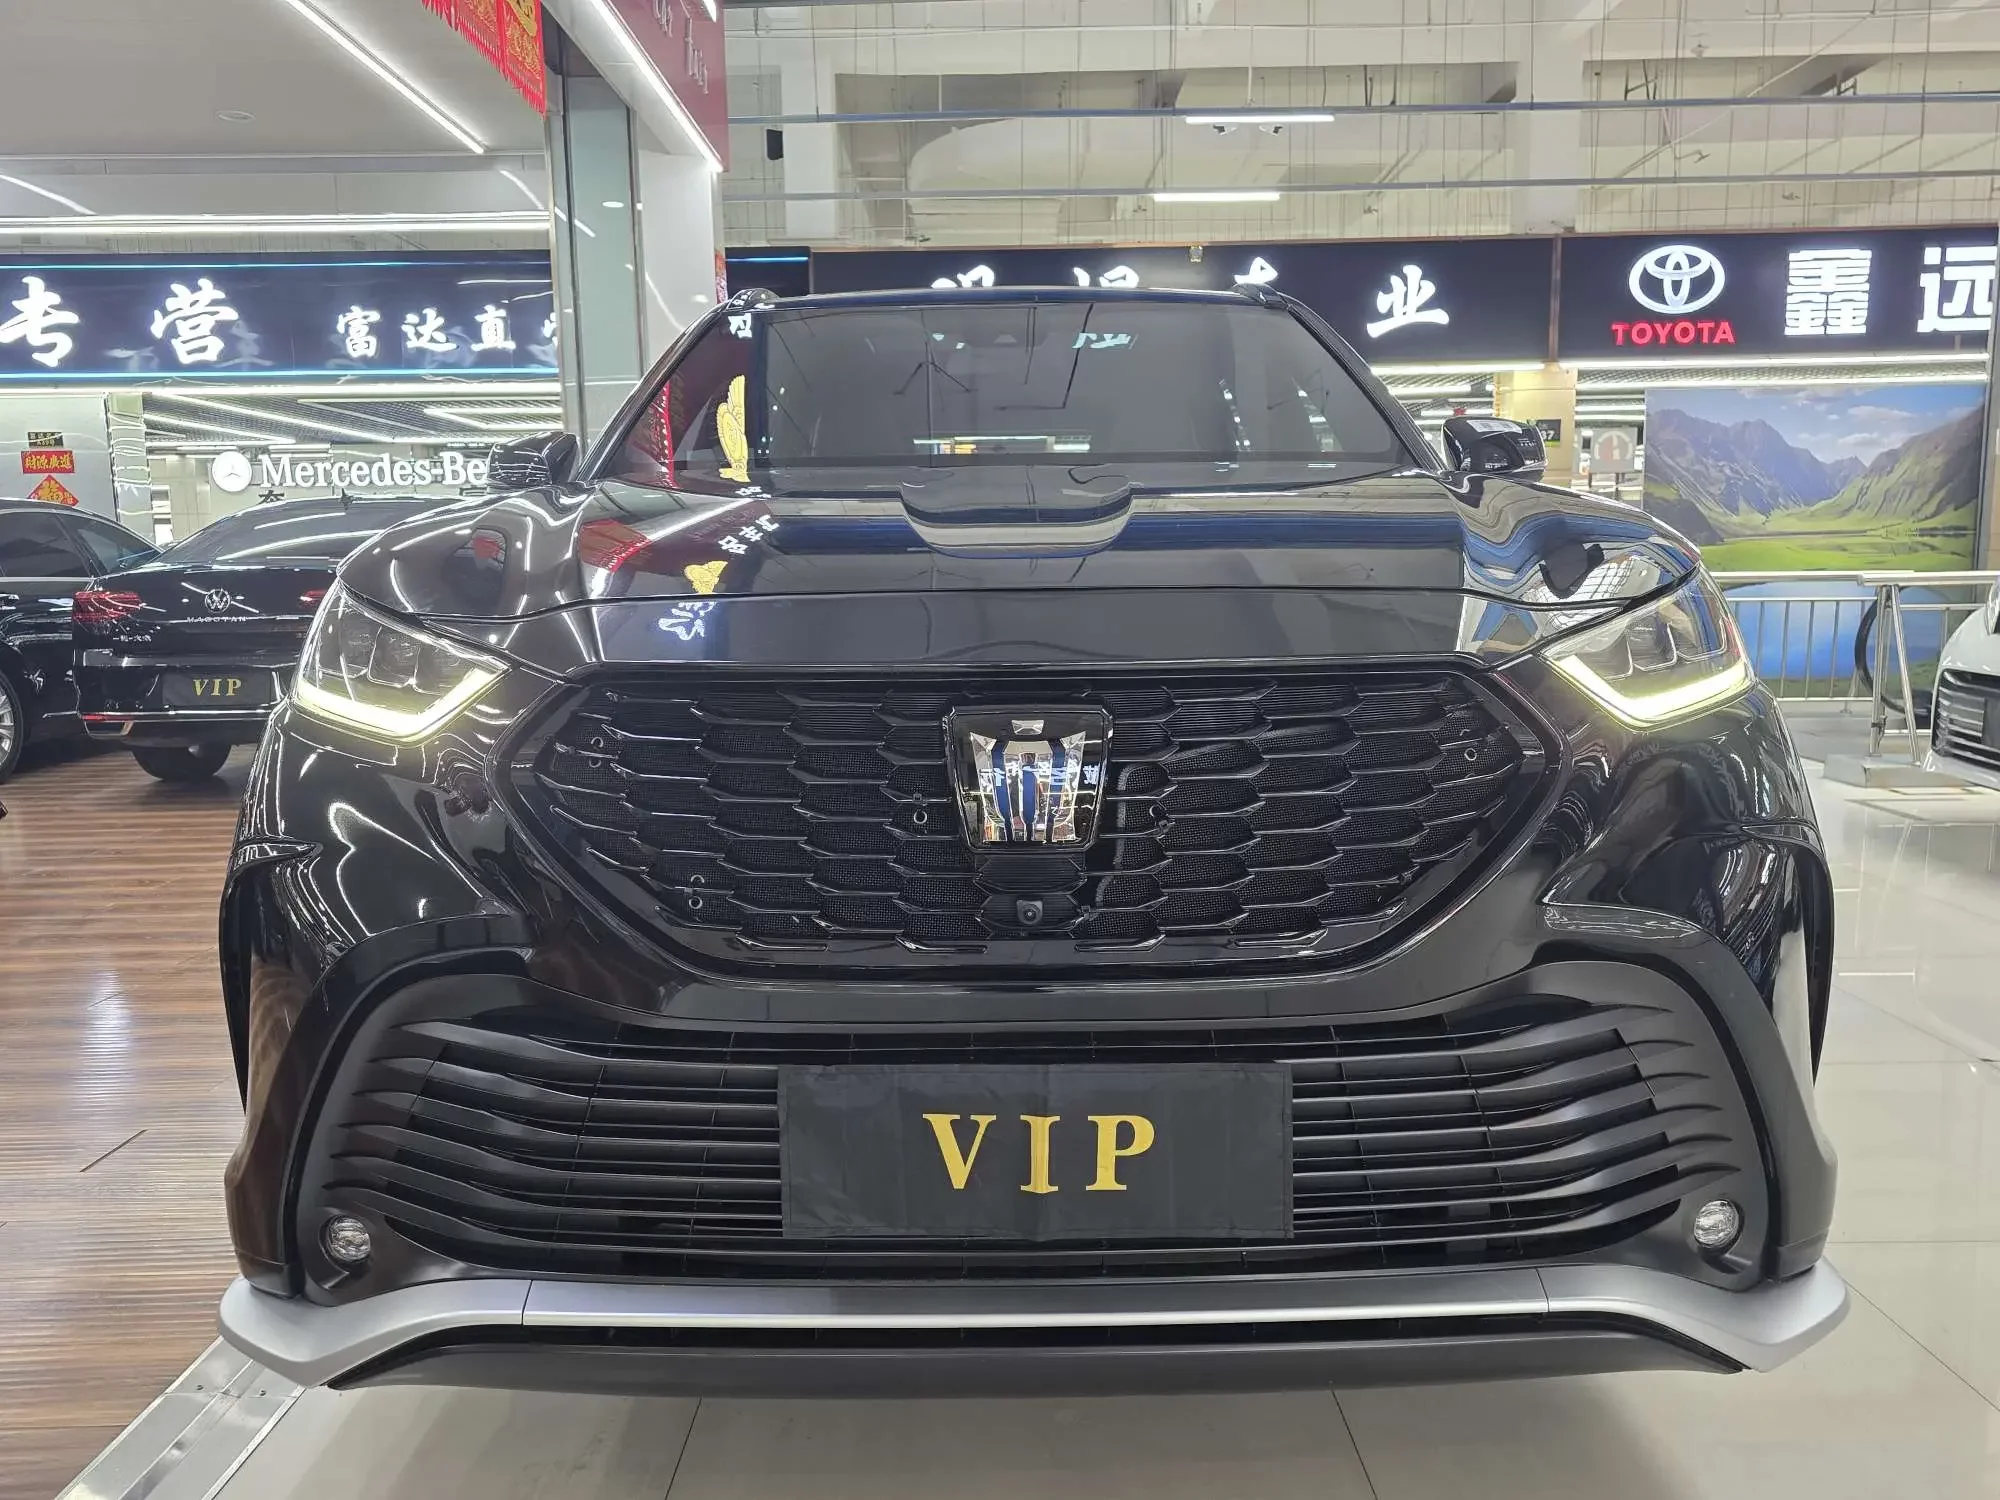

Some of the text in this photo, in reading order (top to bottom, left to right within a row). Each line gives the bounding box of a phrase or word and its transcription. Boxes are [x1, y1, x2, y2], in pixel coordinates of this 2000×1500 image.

[0, 276, 240, 367] 专营
[1784, 246, 1997, 337] 鑫远
[1612, 321, 1735, 346] TOYOTA
[193, 678, 242, 696] VIP
[922, 1113, 1156, 1193] VIP
